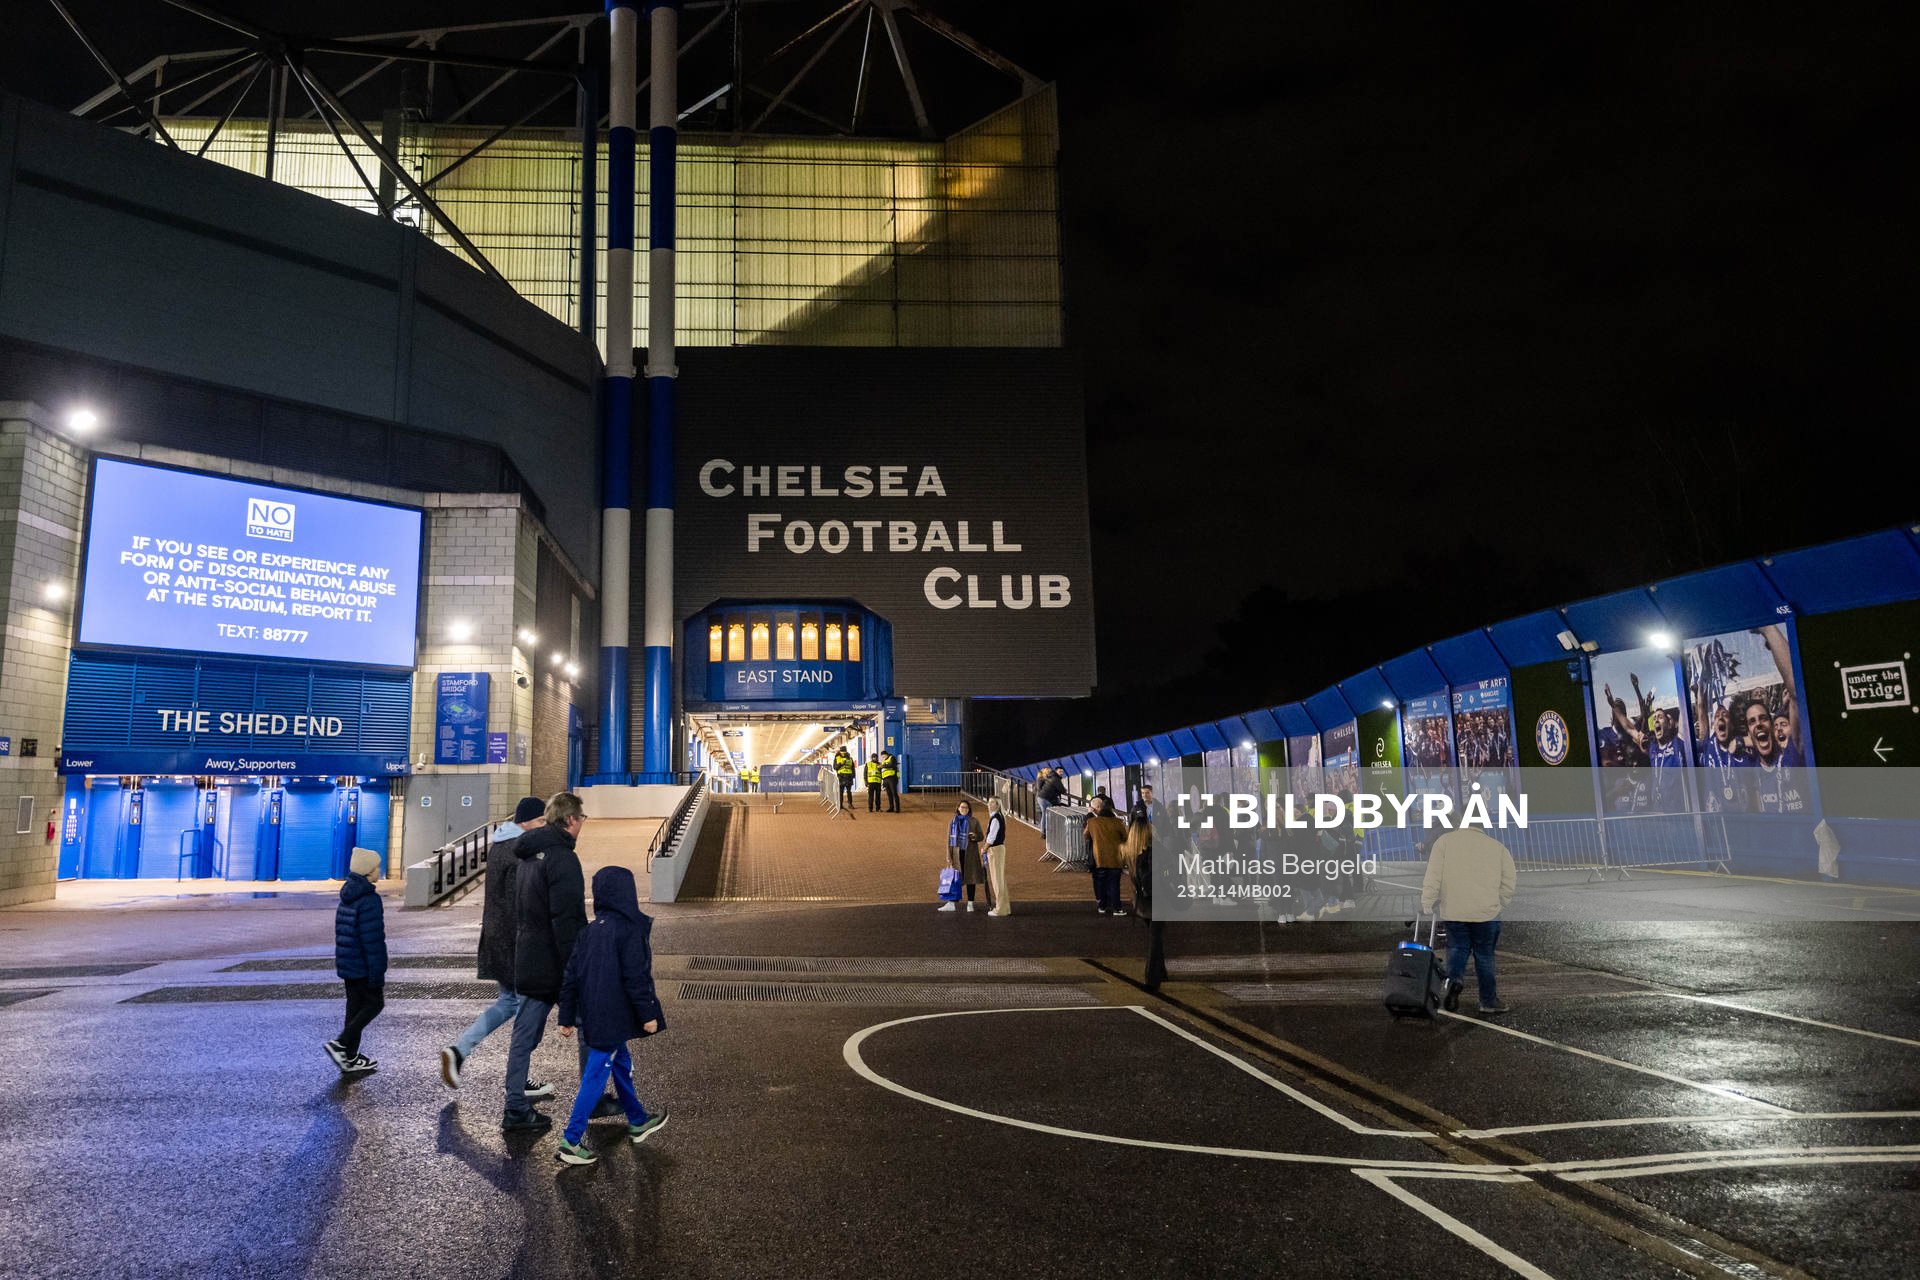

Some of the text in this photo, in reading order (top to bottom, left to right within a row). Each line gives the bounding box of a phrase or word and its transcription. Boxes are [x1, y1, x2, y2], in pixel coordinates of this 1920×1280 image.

[699, 458, 947, 498] CHELSEA
[252, 503, 291, 525] NO
[250, 525, 290, 538] TO HATE
[748, 513, 1022, 554] FOOTBALL
[132, 535, 390, 580] IF YOU SEE OR EXPERIENCE ANY
[120, 551, 396, 596] FORM OF DISCRIMINATION, ABUSE
[143, 571, 377, 608] OR ANTI-SOCIAL BEHAVIOUR
[924, 567, 1072, 610] CLUB
[146, 588, 373, 623] AT THE STADIUM, REPORT IT.
[217, 623, 309, 643] TEXT: 88777
[737, 670, 833, 683] EAST STAND
[1848, 670, 1900, 684] under the
[1848, 682, 1903, 700] bridge
[157, 709, 343, 737] THE SHED END
[66, 758, 94, 767] Lower
[205, 758, 296, 771] Away Supporters
[1371, 760, 1392, 769] CHELSEA
